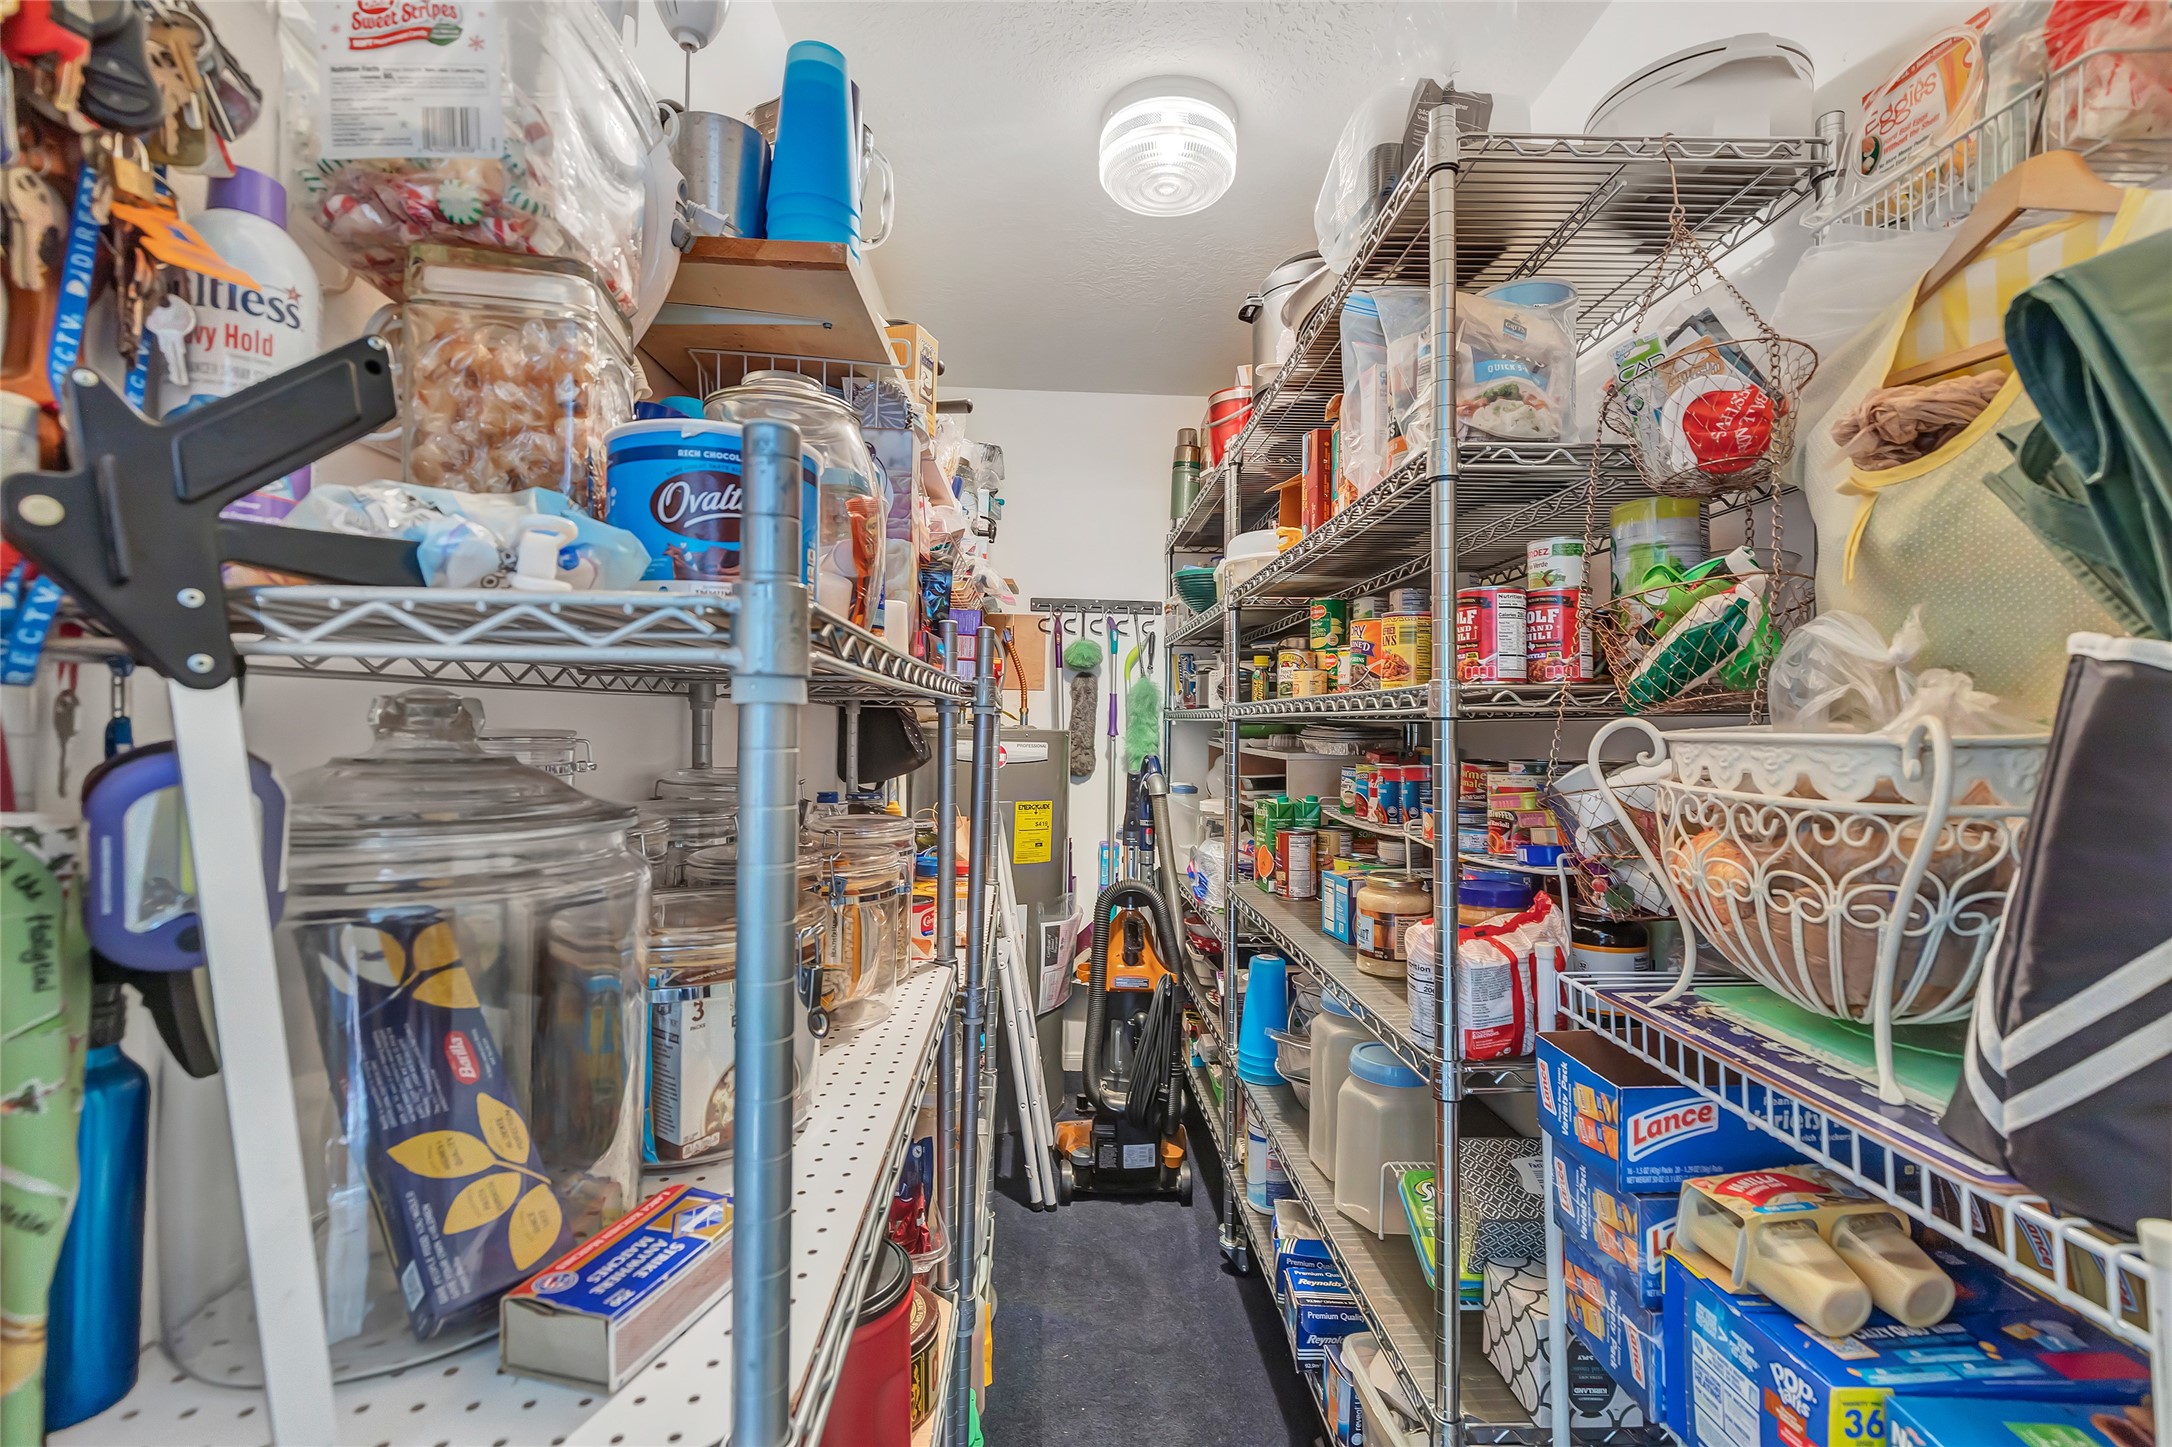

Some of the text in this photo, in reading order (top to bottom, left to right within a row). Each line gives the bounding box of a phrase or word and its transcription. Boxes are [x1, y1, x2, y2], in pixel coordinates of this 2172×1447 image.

[352, 3, 457, 30] Sweet Stripes
[1865, 72, 1936, 135] Eggies
[198, 266, 301, 330] ltless
[225, 323, 273, 356] Hold
[1488, 363, 1515, 373] QUICK
[678, 449, 742, 462] RICH CHOCOL
[657, 481, 743, 525] Ovalt
[691, 1000, 705, 1022] 3
[451, 1035, 477, 1080] Barilla
[1540, 1061, 1551, 1110] Lance
[1561, 1062, 1570, 1136] Variety Pack
[1634, 1104, 1713, 1147] Lance
[1579, 1165, 1587, 1191] Pack
[585, 1235, 656, 1284] MATCHES
[632, 1241, 686, 1279] STRIKE
[2023, 1217, 2054, 1267] ance
[588, 1238, 668, 1296] ANYWHERE
[1286, 1258, 1315, 1268] Premium
[1298, 1278, 1343, 1288] Reynolds
[1307, 1311, 1364, 1323] Premium Quality
[1844, 1409, 1885, 1439] 36
